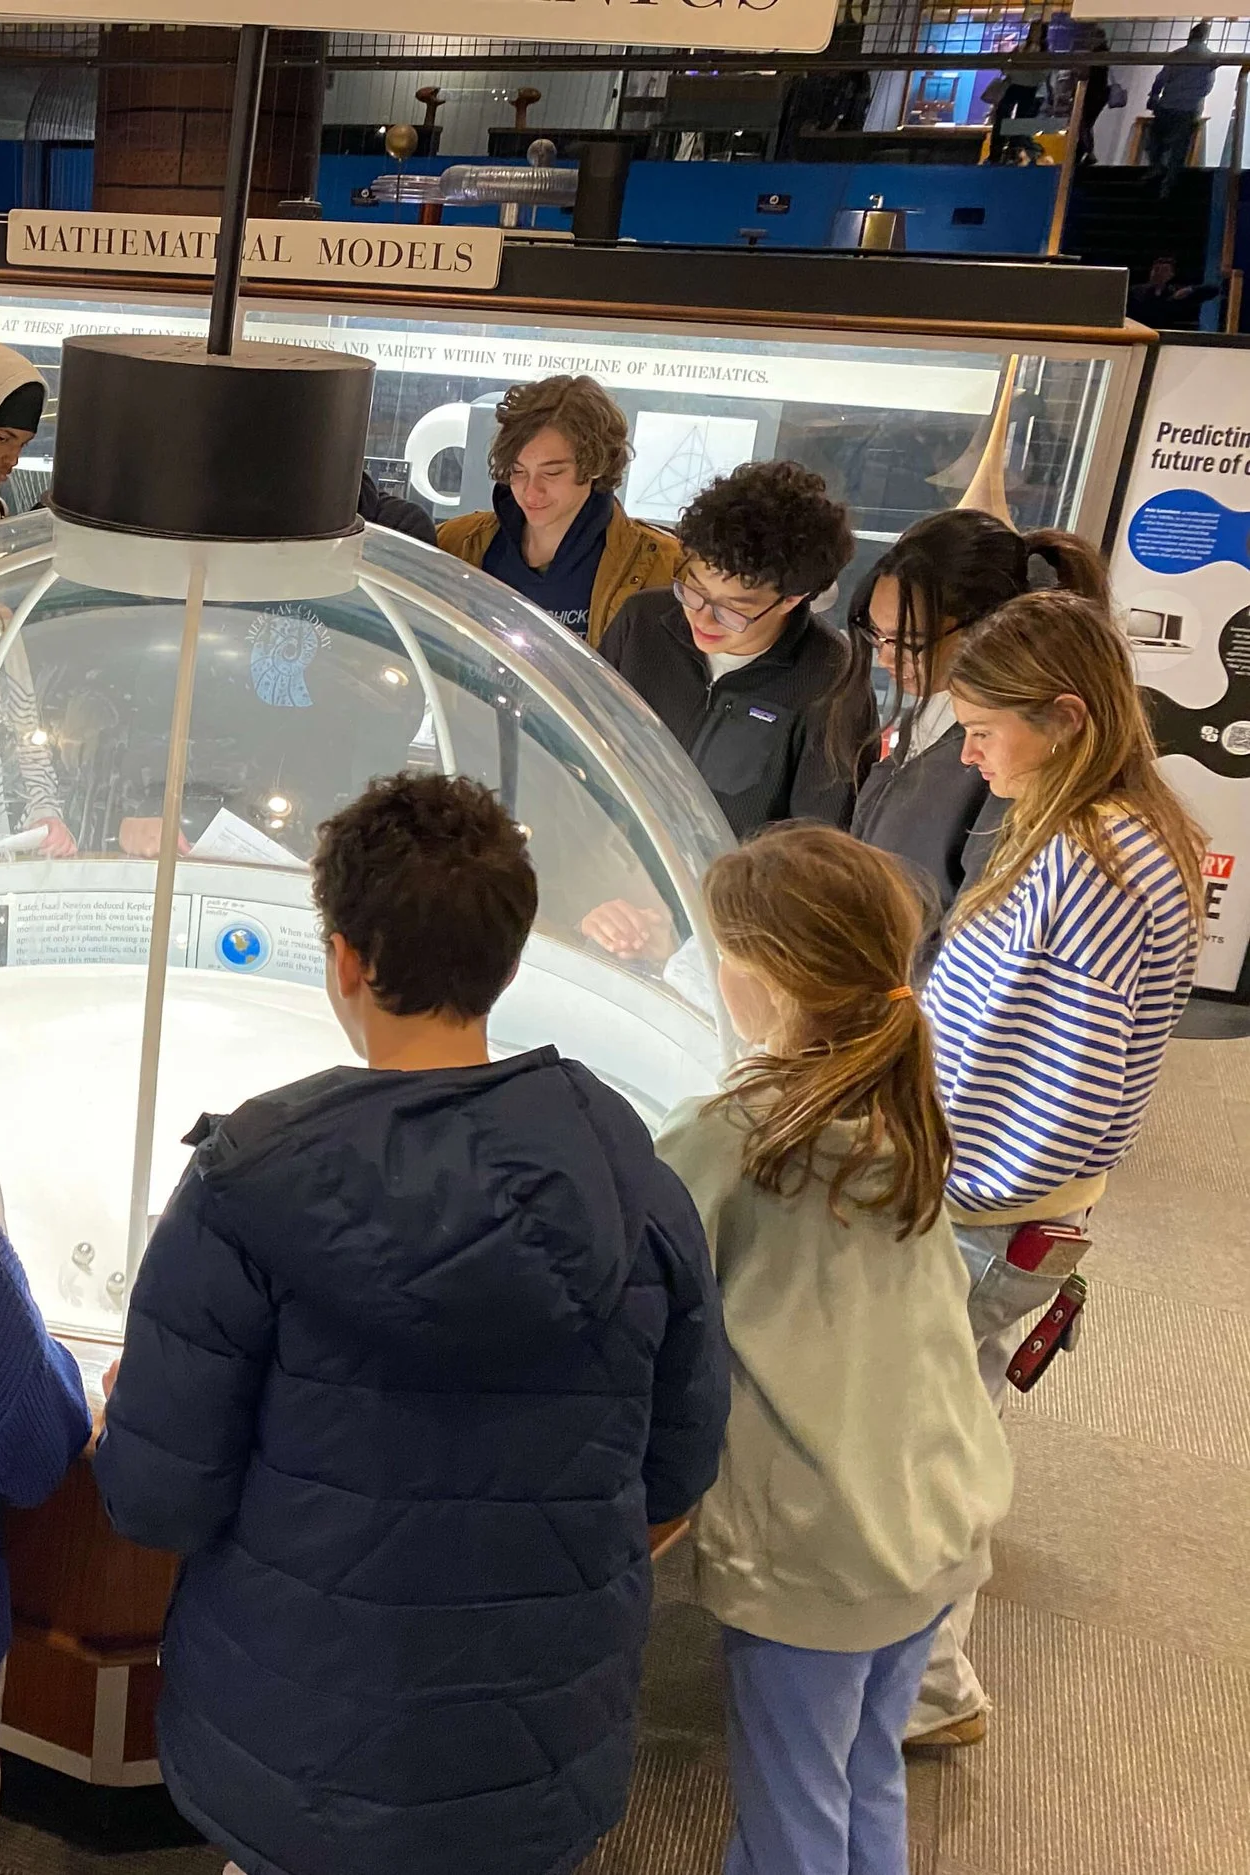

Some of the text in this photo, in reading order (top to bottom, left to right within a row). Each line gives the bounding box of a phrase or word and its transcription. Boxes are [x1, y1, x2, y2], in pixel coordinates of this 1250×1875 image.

[22, 224, 473, 272] MATHEMATIAL MODELS
[1, 318, 20, 332] AT
[23, 319, 64, 335] THESE
[341, 342, 369, 355] AND
[377, 343, 437, 360] VARIETY
[443, 347, 496, 364] WITHIN
[502, 351, 533, 368] THE
[538, 355, 621, 374] DISCIPLINE
[627, 360, 647, 375] OF
[654, 363, 769, 384] MATHEMATICS.
[1151, 448, 1215, 473] future
[1218, 453, 1244, 475] of
[1202, 855, 1230, 876] RY
[93, 902, 125, 910] deduced
[1205, 882, 1228, 919] E
[17, 913, 72, 923] mathematically
[75, 912, 94, 922] from
[95, 912, 107, 921] his
[127, 913, 143, 921] laws
[45, 924, 60, 932] and
[105, 923, 140, 933] Newton's
[280, 925, 302, 937] When
[53, 934, 69, 944] only
[110, 934, 138, 945] moving
[138, 946, 147, 954] to
[290, 940, 326, 952] resistan
[295, 962, 313, 974] they
